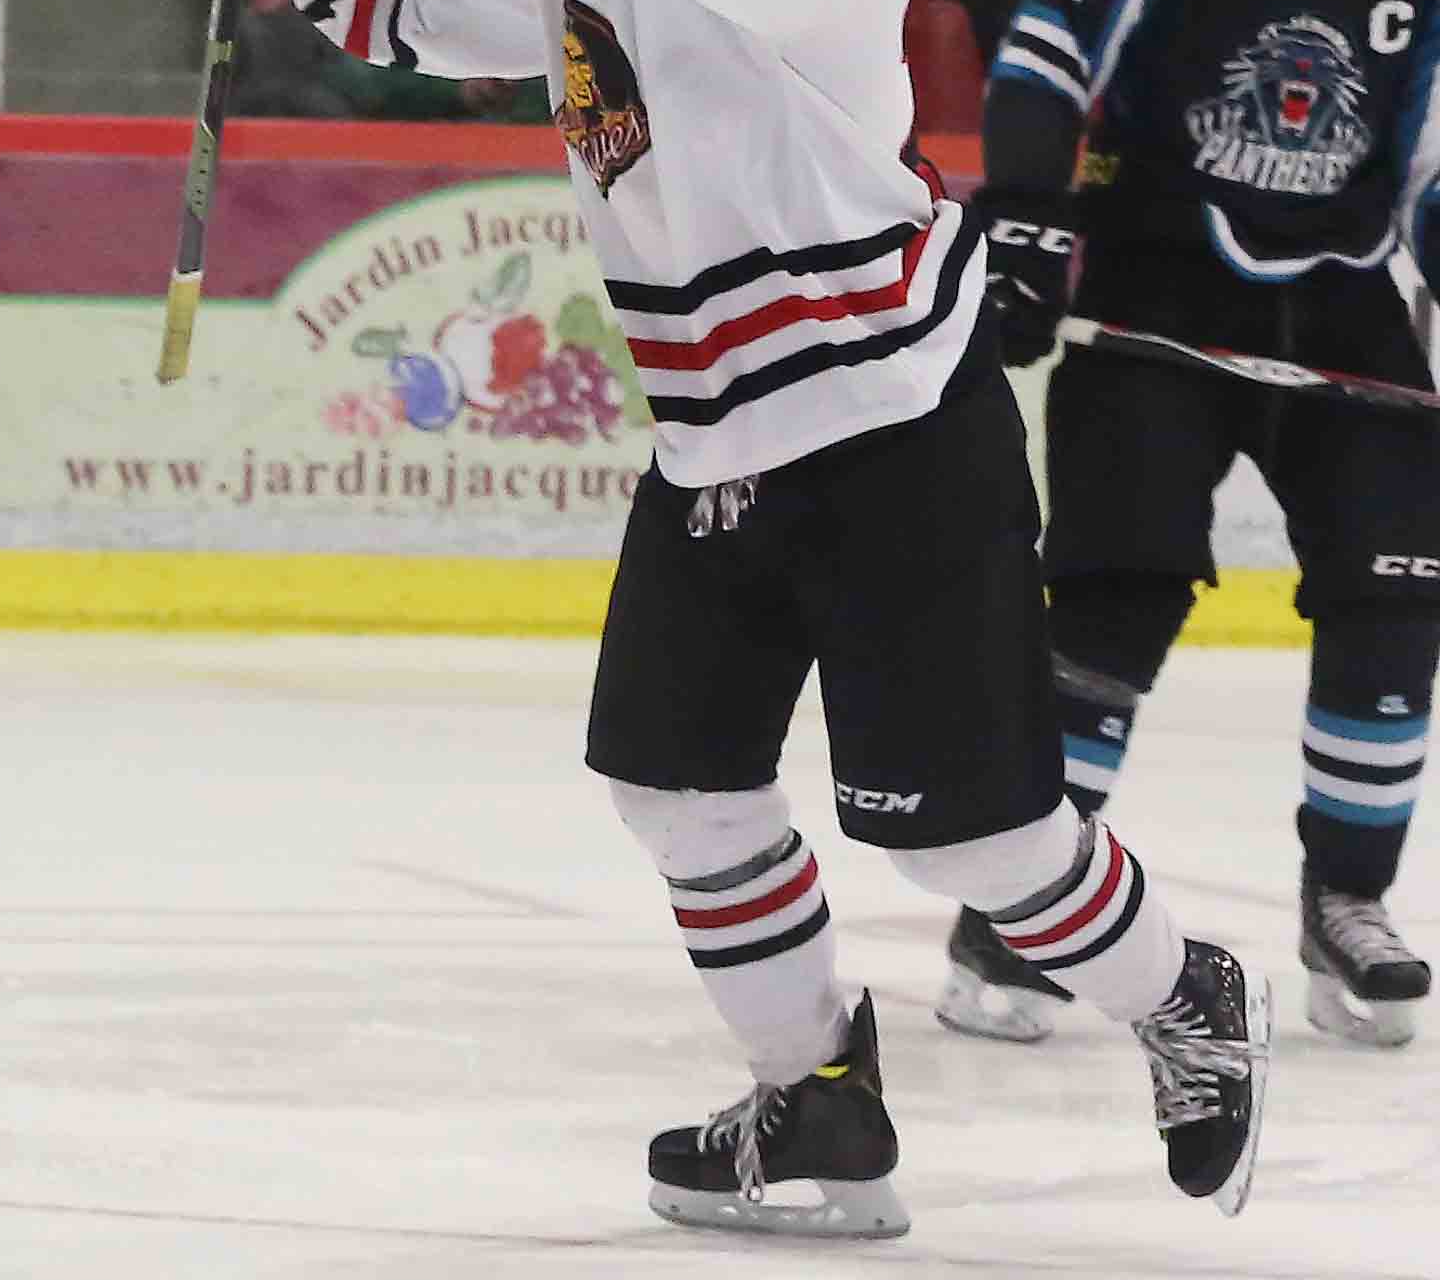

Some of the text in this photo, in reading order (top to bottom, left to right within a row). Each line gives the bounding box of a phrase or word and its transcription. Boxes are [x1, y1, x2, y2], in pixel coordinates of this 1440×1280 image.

[1368, 0, 1415, 55] C
[987, 219, 1076, 256] CC
[294, 234, 444, 353] Jardin
[1371, 553, 1440, 579] CC
[836, 780, 924, 815] CCM
